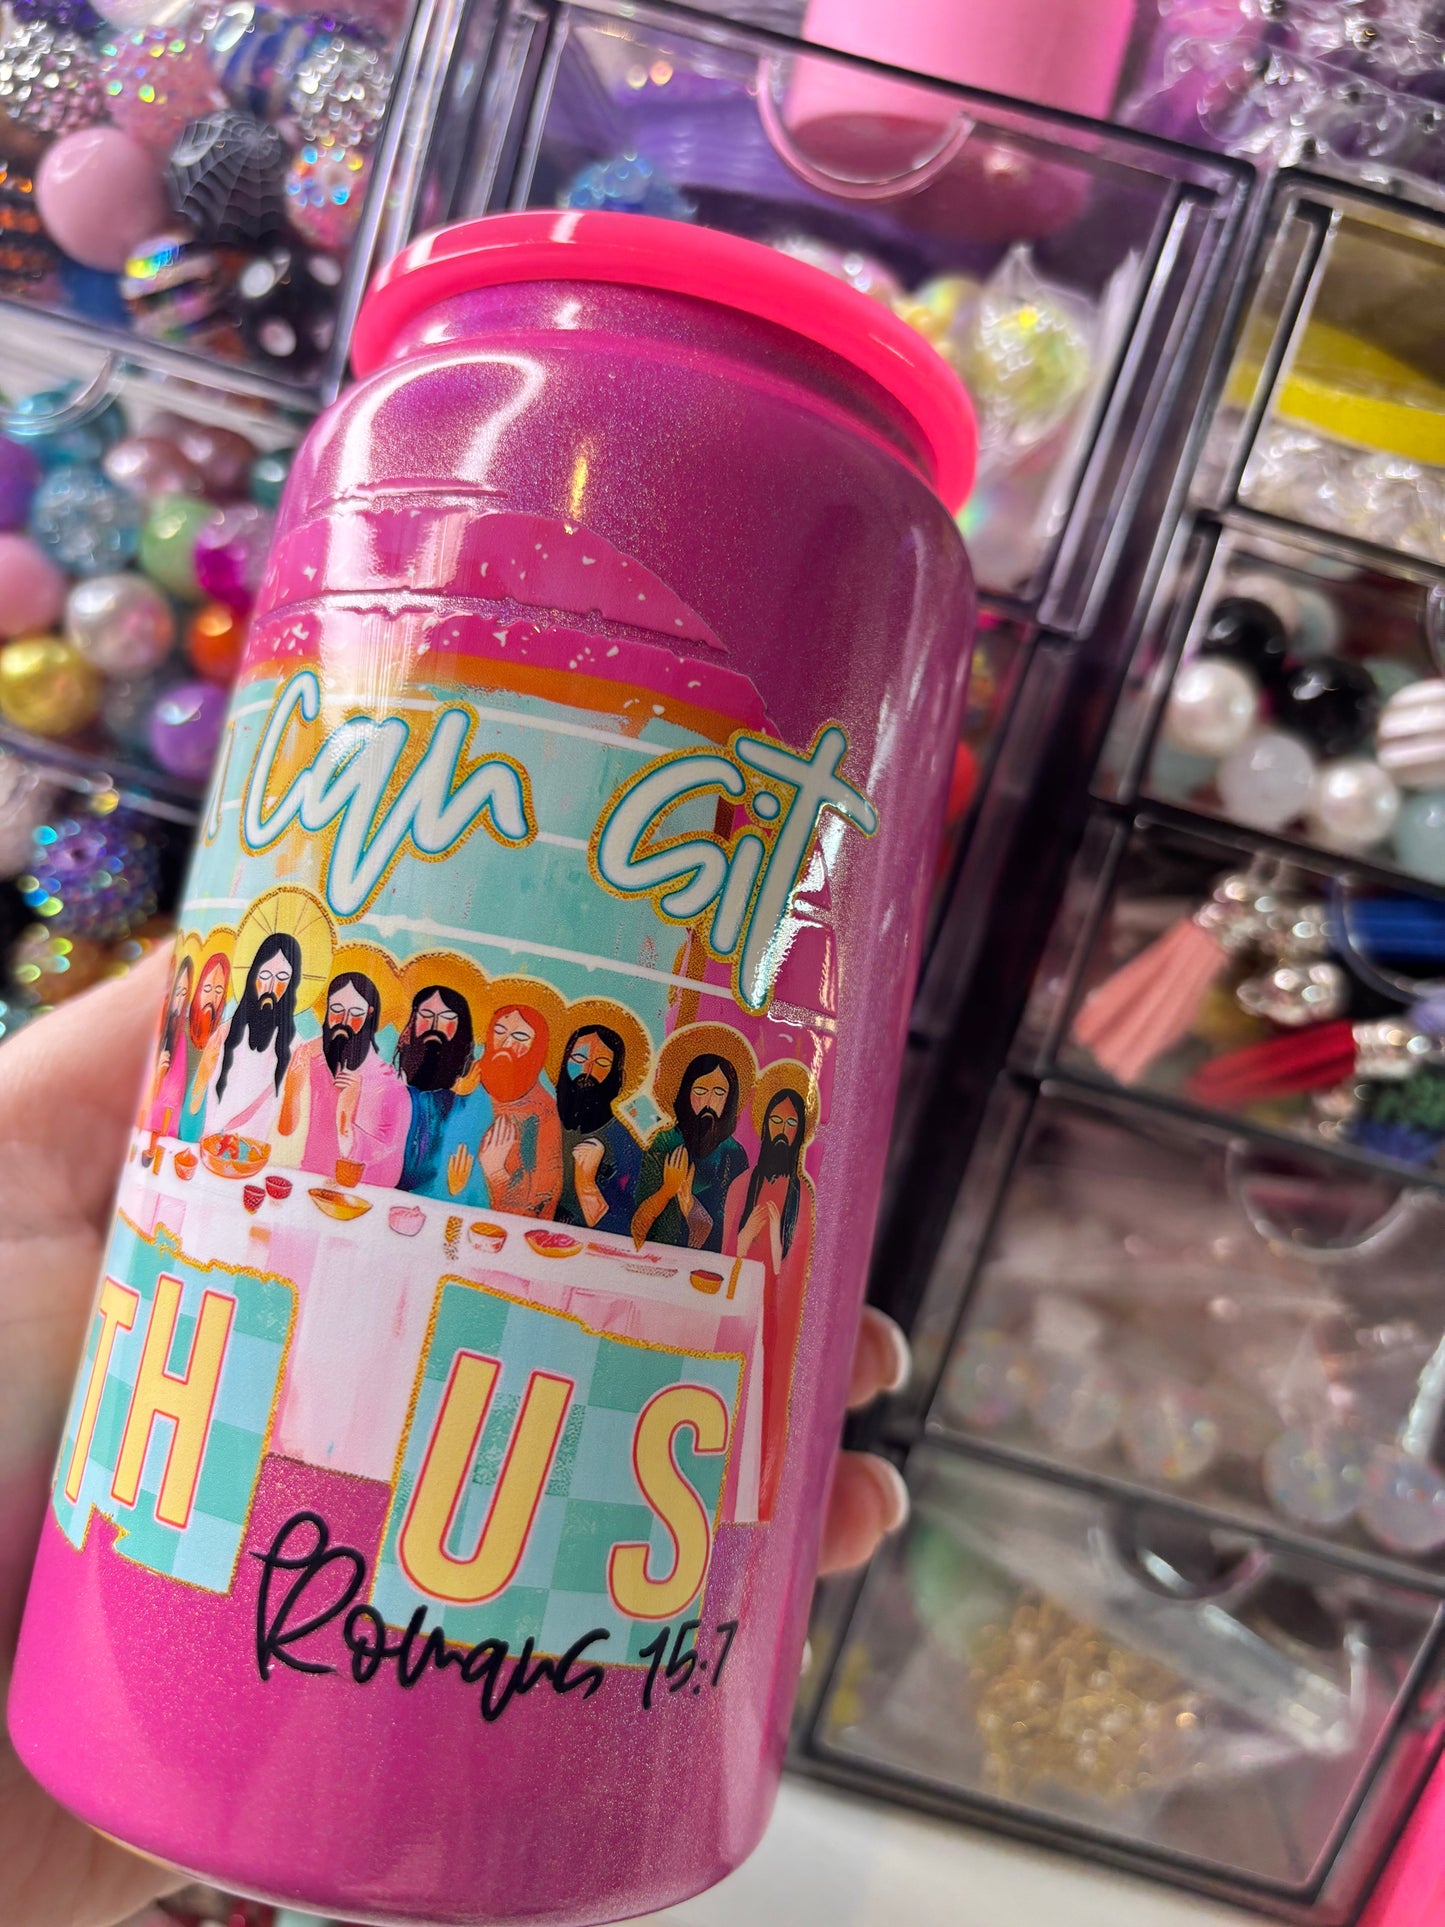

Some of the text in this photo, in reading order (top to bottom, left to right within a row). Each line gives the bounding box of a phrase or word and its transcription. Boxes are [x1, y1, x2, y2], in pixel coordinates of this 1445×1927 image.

[399, 1350, 729, 1620] US
[249, 1511, 739, 1721] Romans 15:7
